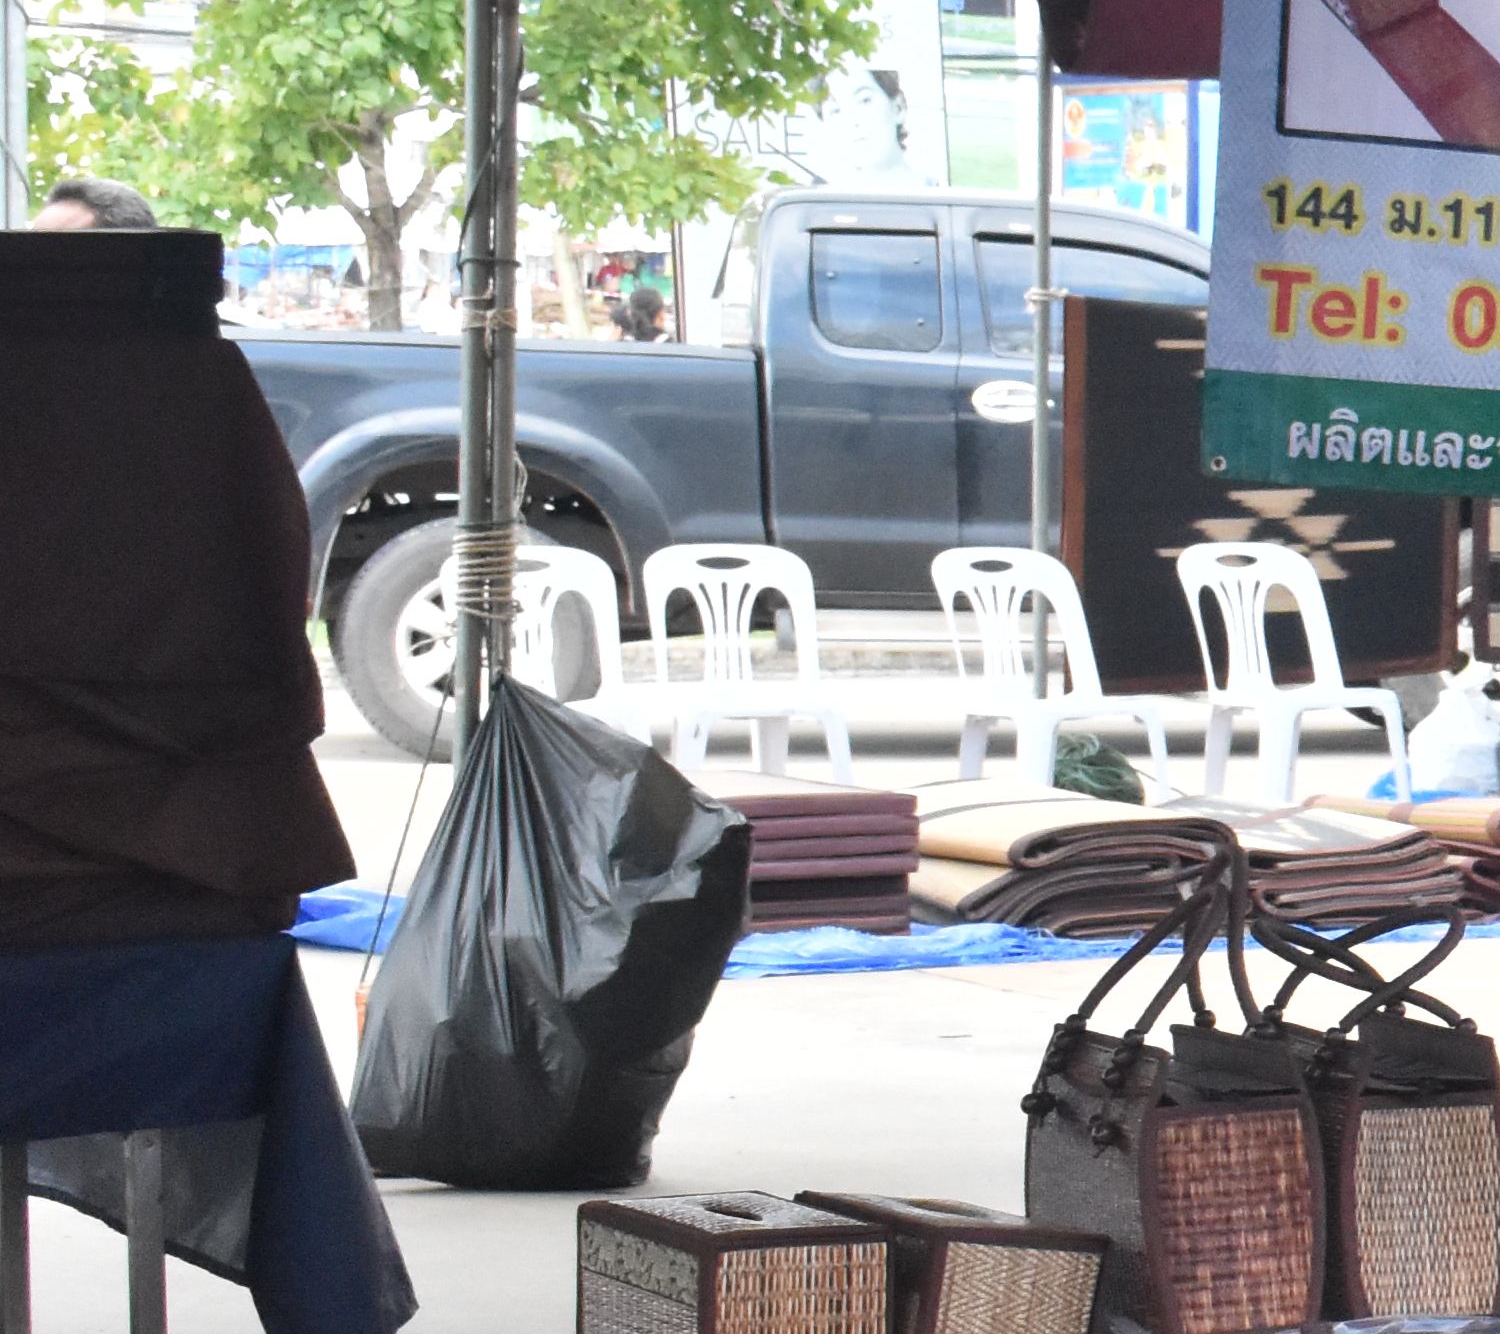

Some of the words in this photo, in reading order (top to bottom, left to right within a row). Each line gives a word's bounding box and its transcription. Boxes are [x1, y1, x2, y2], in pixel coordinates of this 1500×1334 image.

[694, 109, 809, 156] SALE
[1266, 183, 1358, 229] 144
[1389, 197, 1495, 242] ม.11
[1260, 268, 1402, 342] Tel:
